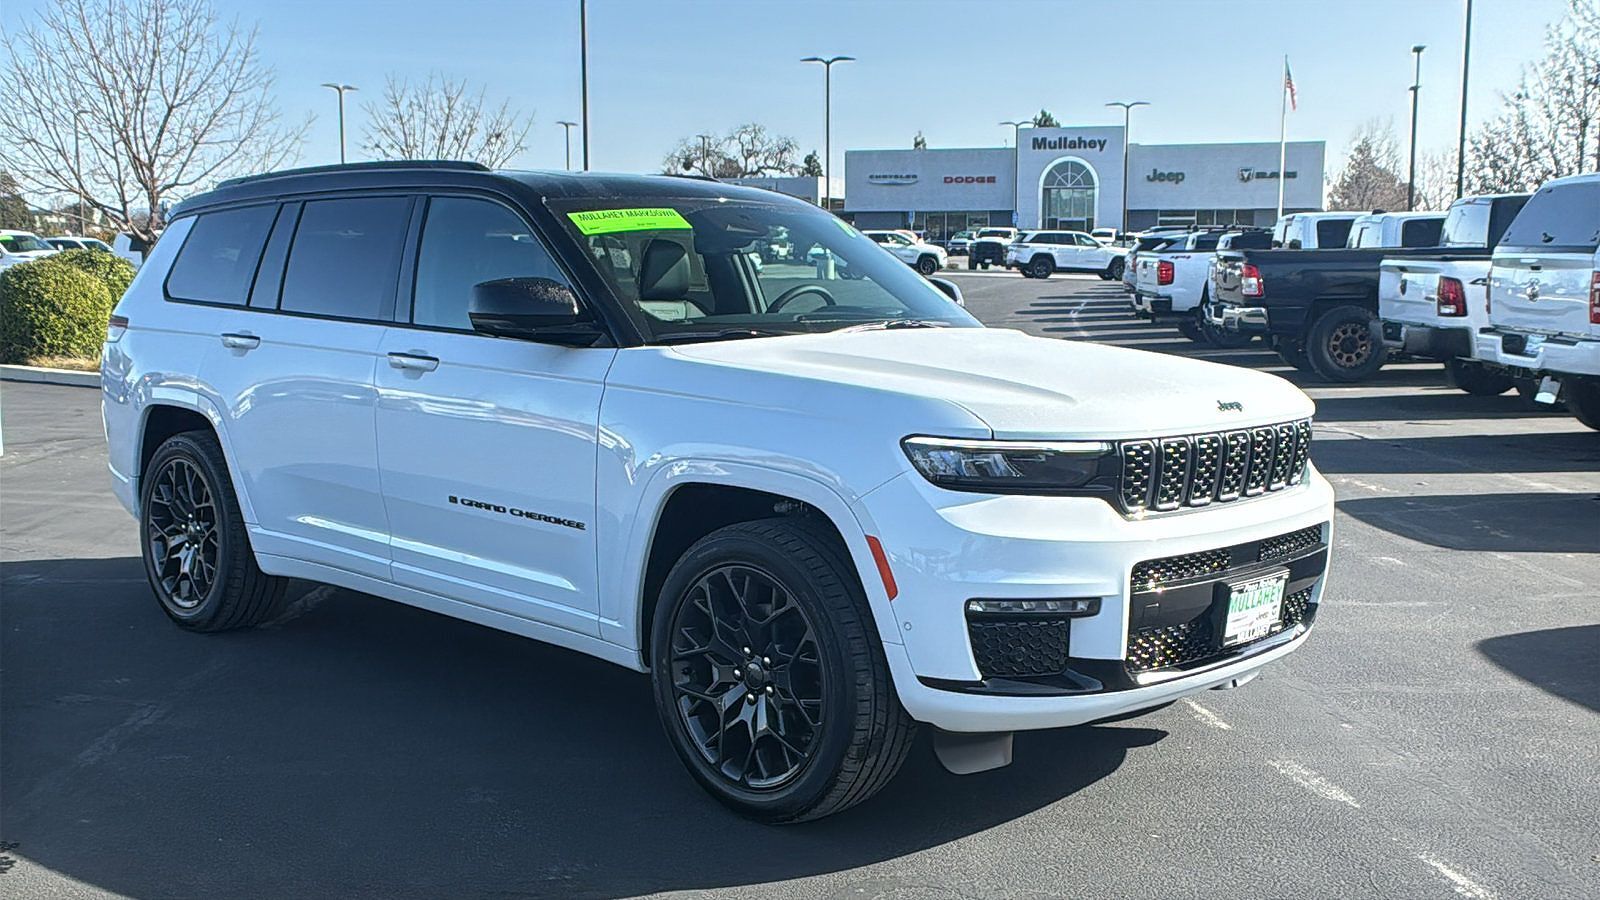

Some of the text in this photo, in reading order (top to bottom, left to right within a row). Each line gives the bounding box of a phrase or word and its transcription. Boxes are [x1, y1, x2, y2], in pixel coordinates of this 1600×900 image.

[1032, 136, 1107, 152] Mullahey
[943, 176, 996, 184] DODGE
[1146, 168, 1185, 185] Jeep
[578, 209, 677, 222] MULLAHEY MARKDOWN
[1216, 400, 1243, 412] Jeep
[460, 498, 586, 531] GRAND CHEROKEE
[1229, 585, 1283, 614] MULLAHEY
